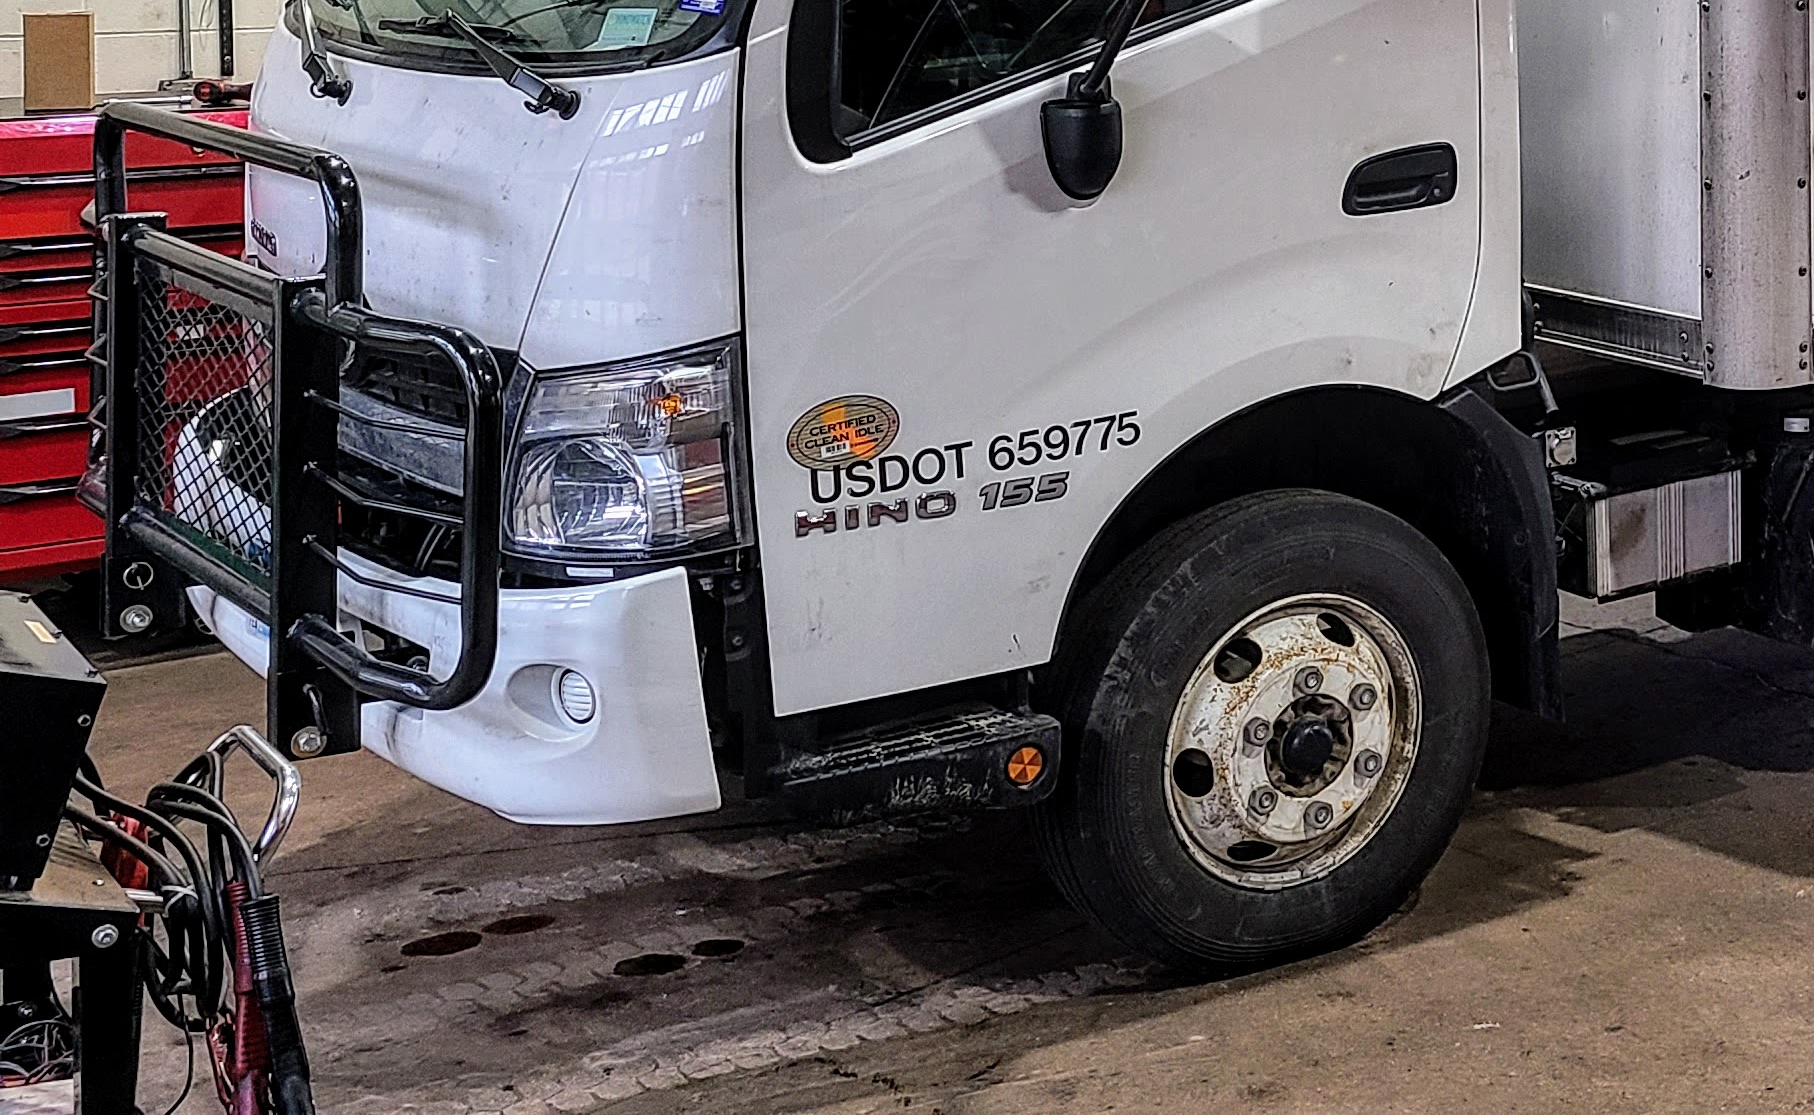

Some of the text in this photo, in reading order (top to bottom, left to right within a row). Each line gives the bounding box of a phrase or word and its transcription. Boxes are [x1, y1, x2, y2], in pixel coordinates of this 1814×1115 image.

[804, 432, 849, 450] CLEAN
[855, 424, 884, 439] IDLE
[809, 414, 877, 437] CERTIFIED
[810, 411, 1141, 504] USDOT 659775
[795, 471, 1070, 538] HINO 155
